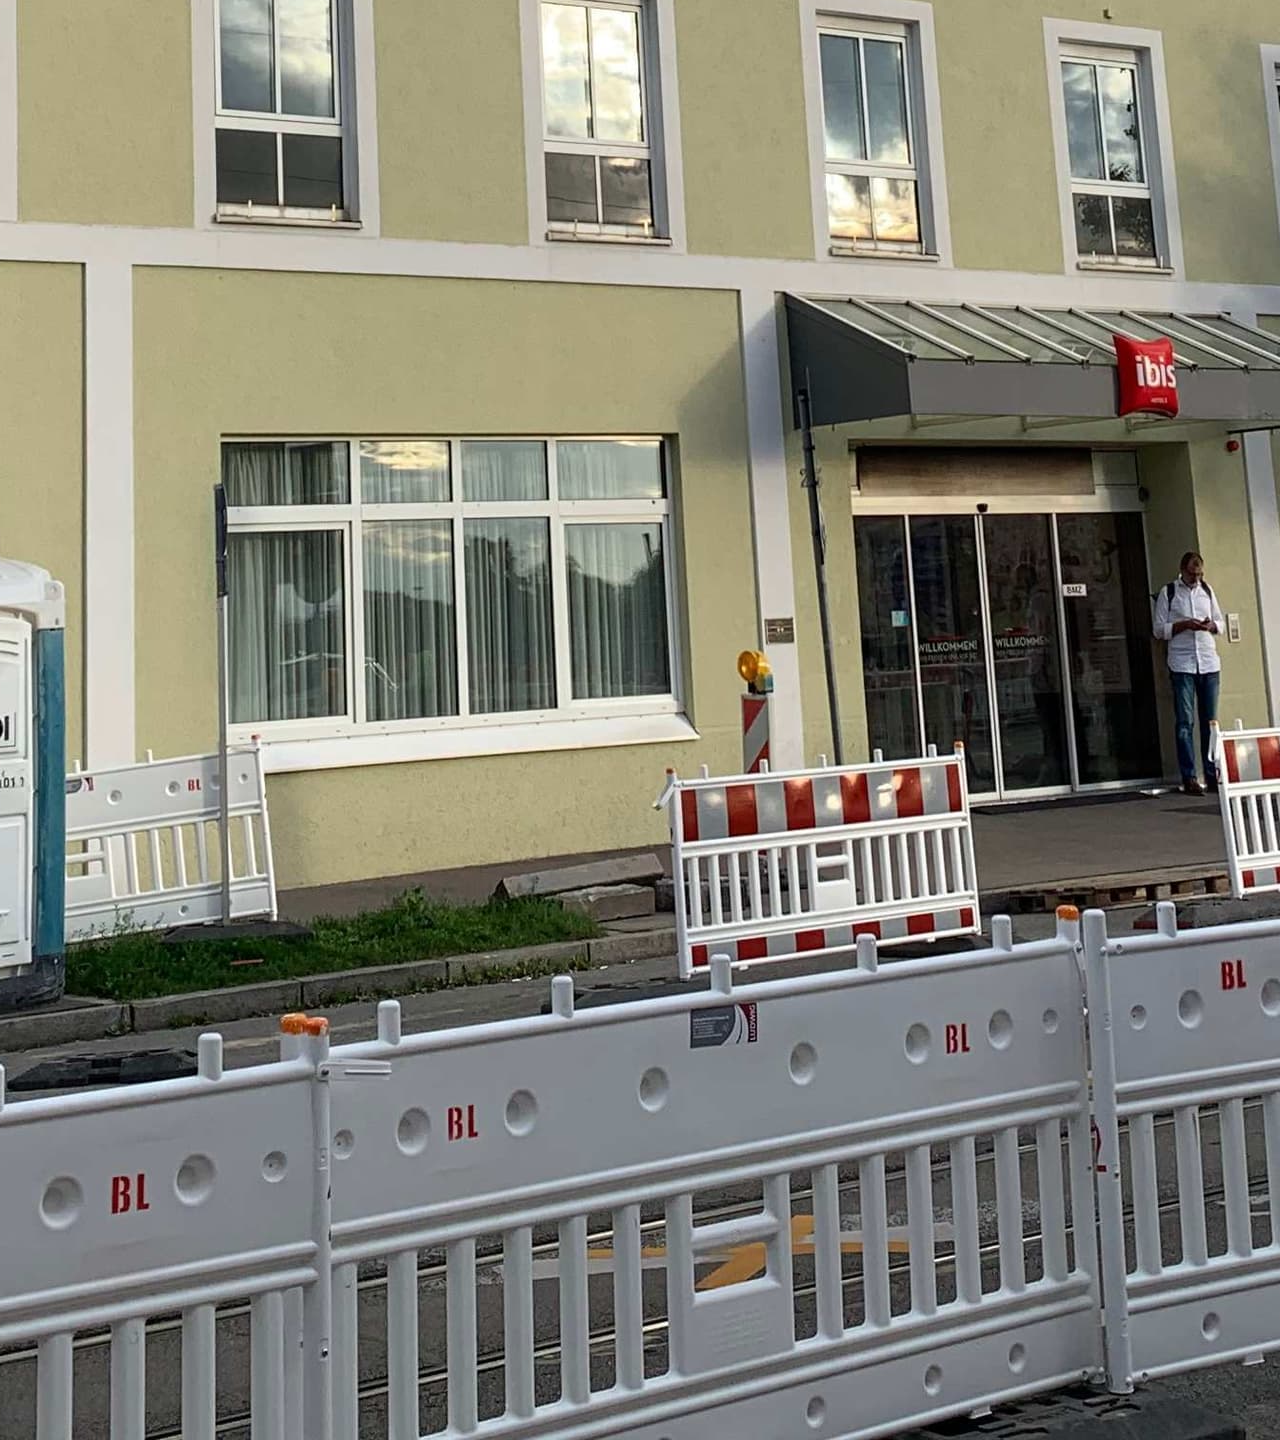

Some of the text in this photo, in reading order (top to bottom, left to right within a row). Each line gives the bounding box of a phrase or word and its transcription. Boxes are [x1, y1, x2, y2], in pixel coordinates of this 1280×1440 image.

[1135, 355, 1176, 388] ibis
[187, 778, 201, 792] BL
[1221, 961, 1247, 991] BL
[945, 1024, 970, 1053] BL
[446, 1104, 478, 1140] BL
[111, 1173, 149, 1214] BL
